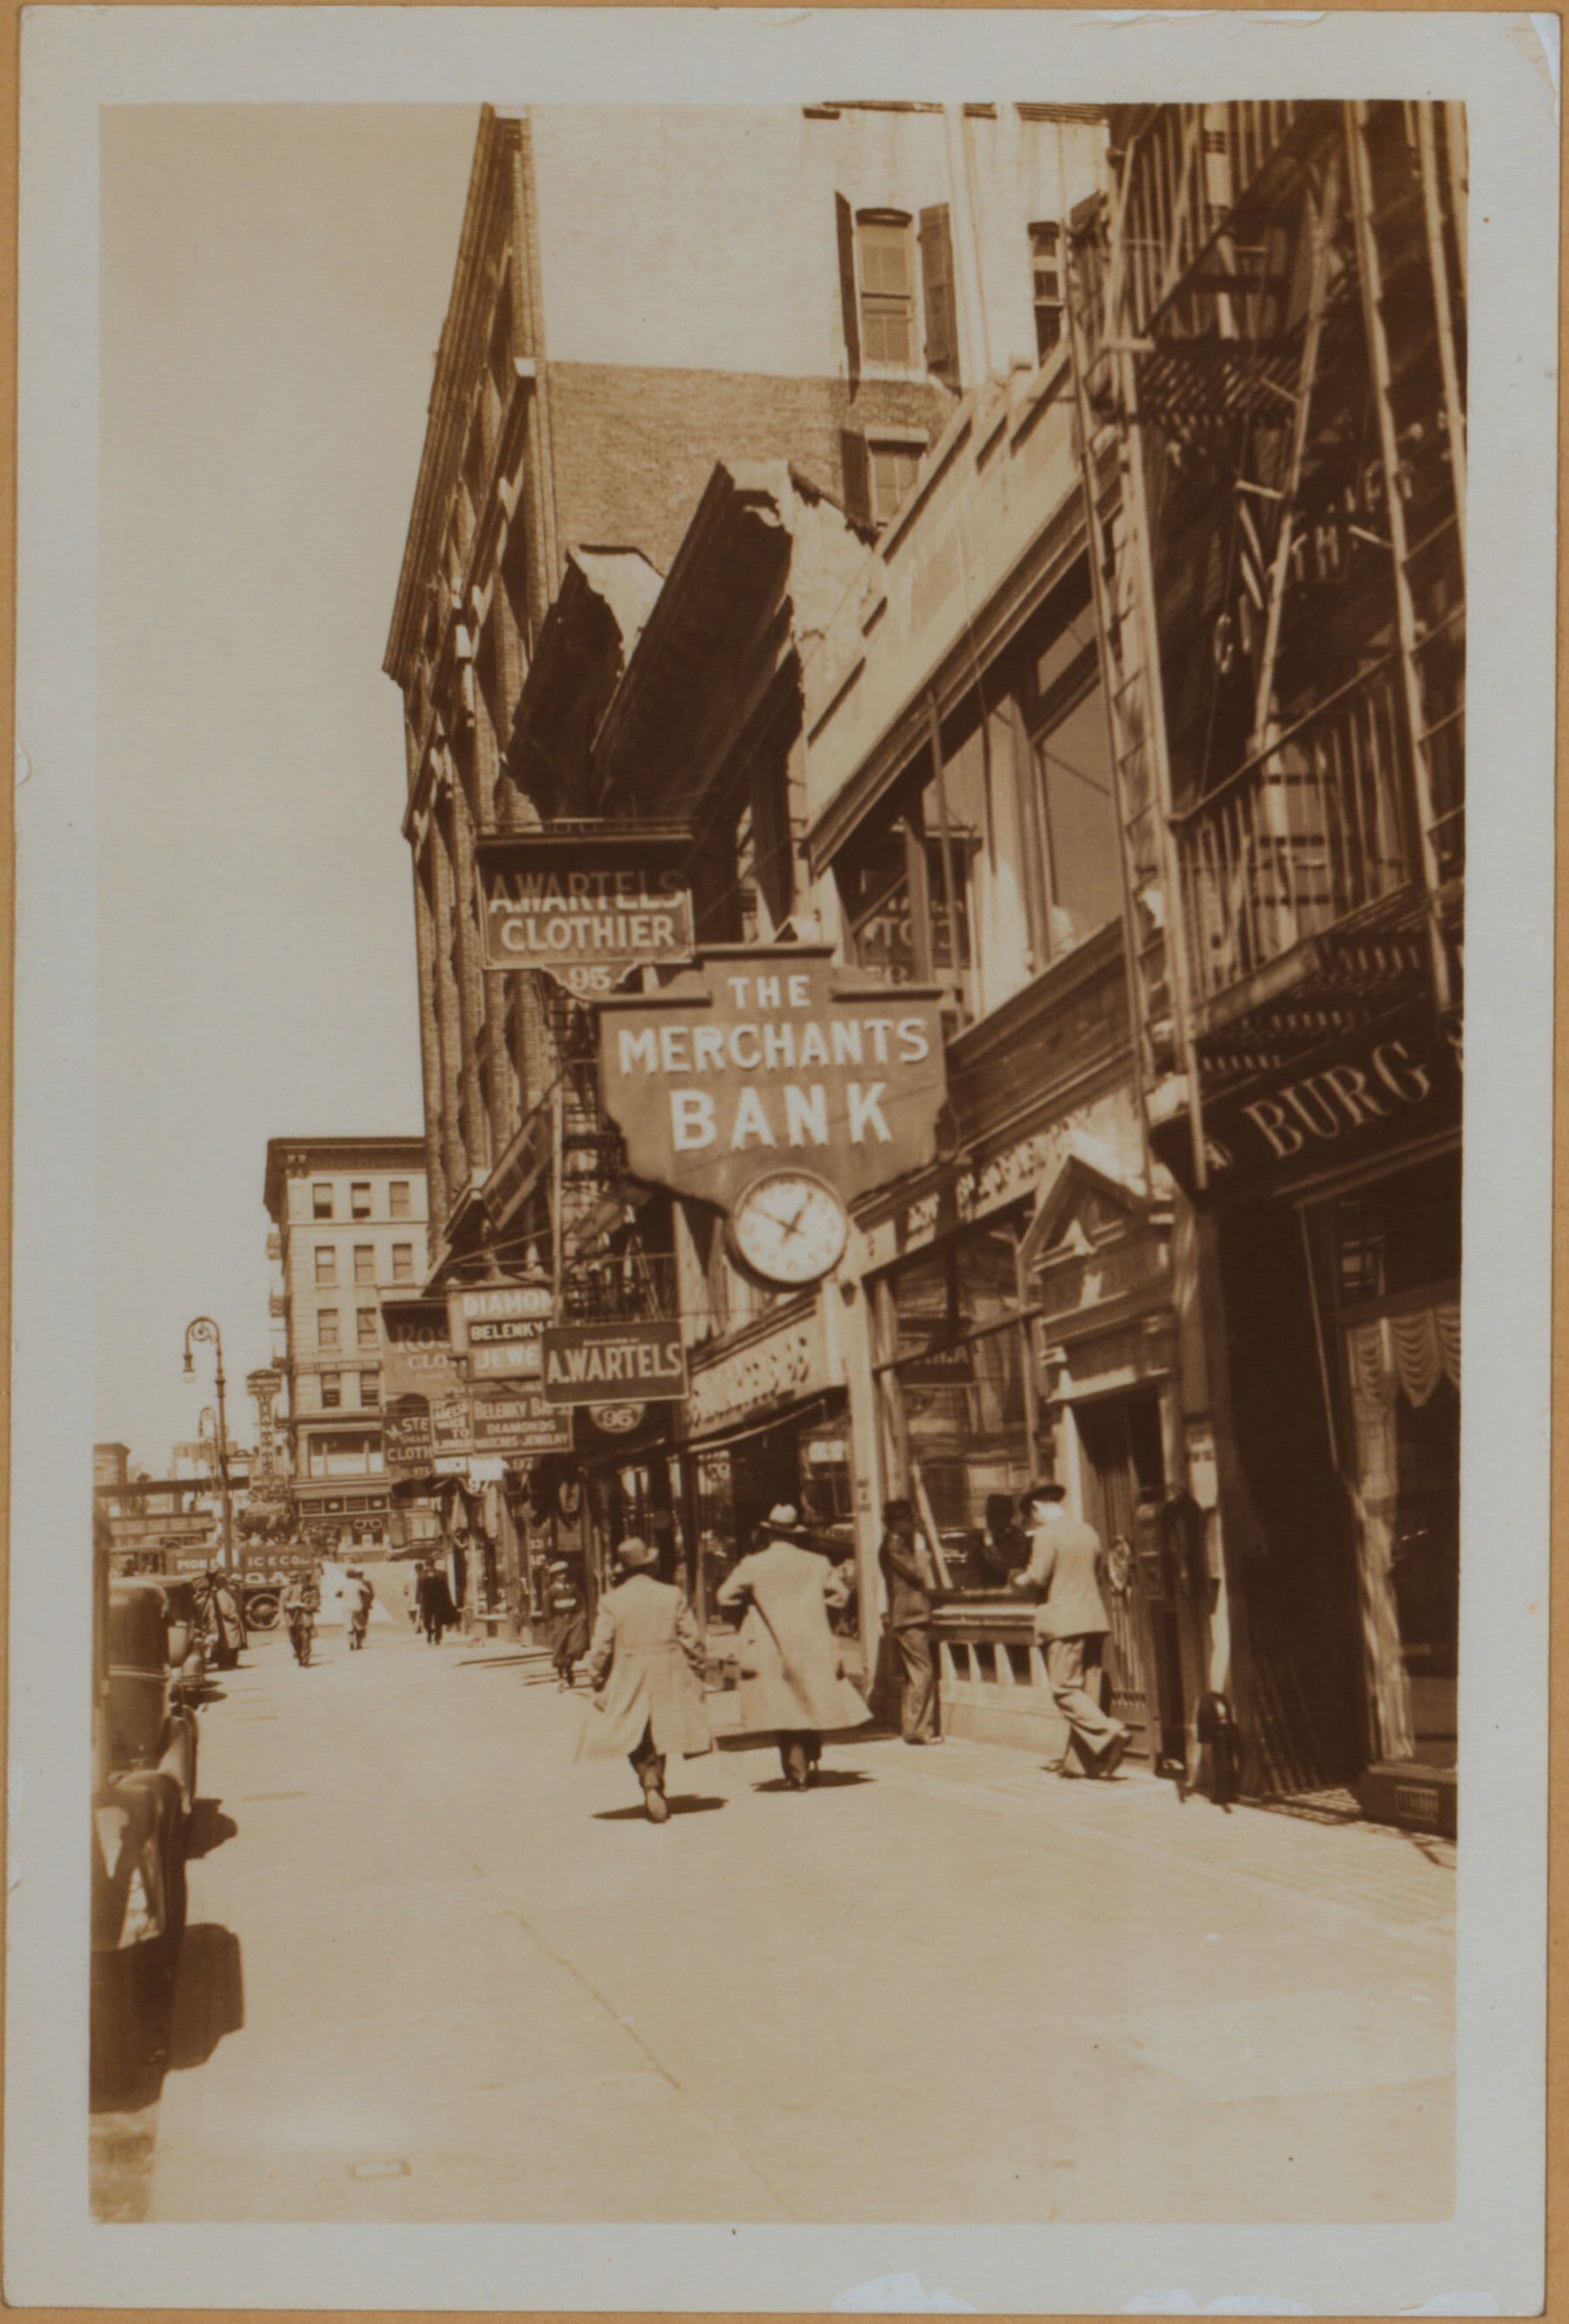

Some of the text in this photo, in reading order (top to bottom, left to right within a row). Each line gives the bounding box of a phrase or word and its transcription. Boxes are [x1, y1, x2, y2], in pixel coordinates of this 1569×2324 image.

[489, 870, 686, 914] A.WARTELS
[501, 915, 675, 951] CLOTHIER
[728, 976, 811, 1008] THE
[619, 1018, 929, 1075] MERCHANTS
[671, 1082, 893, 1152] BANK
[547, 1341, 682, 1385] A.WARTELS
